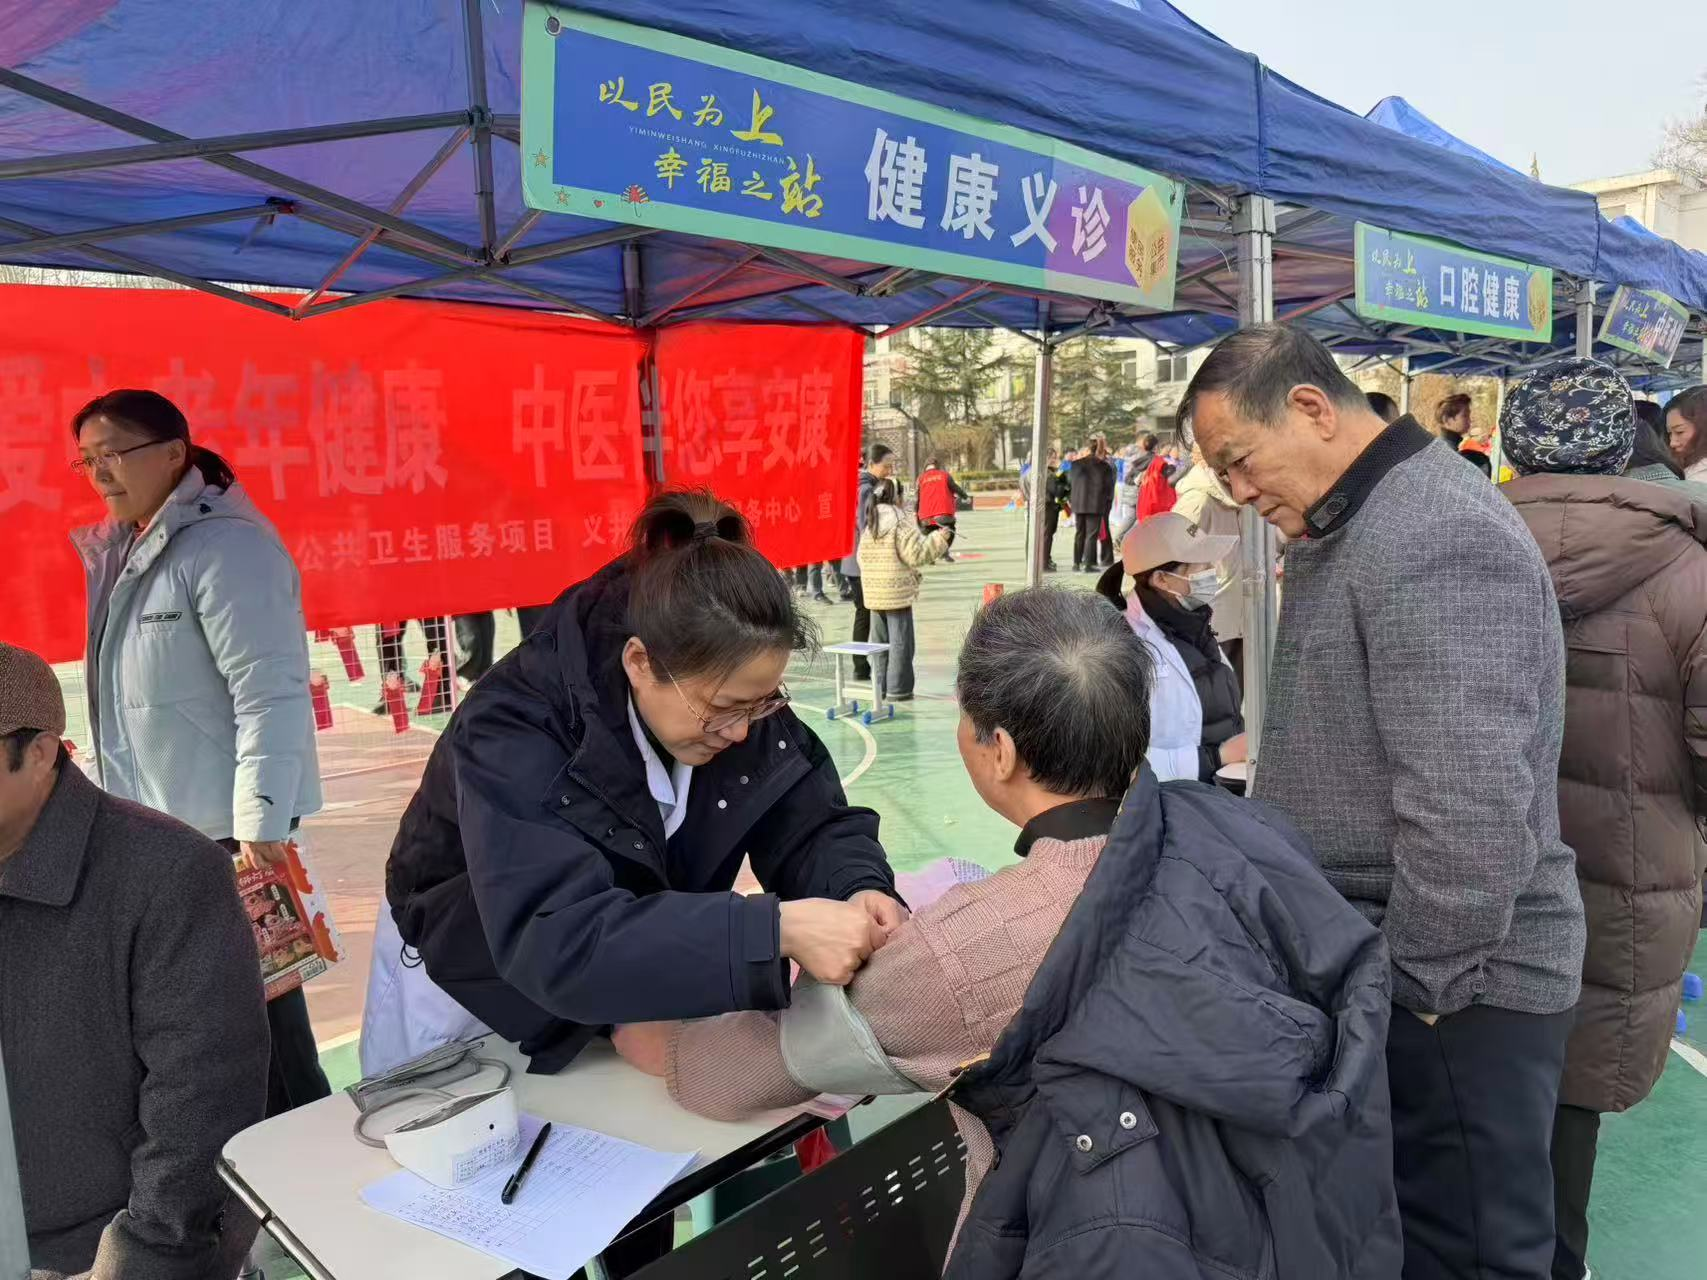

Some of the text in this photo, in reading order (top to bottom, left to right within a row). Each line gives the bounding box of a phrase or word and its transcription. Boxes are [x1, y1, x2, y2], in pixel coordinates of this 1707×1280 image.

[599, 76, 784, 147] 以民为上
[654, 146, 824, 219] 幸福之站
[864, 127, 1111, 263] 健康义诊
[1440, 264, 1520, 321] 口腔健康
[511, 363, 834, 487] 中医伴您享安康
